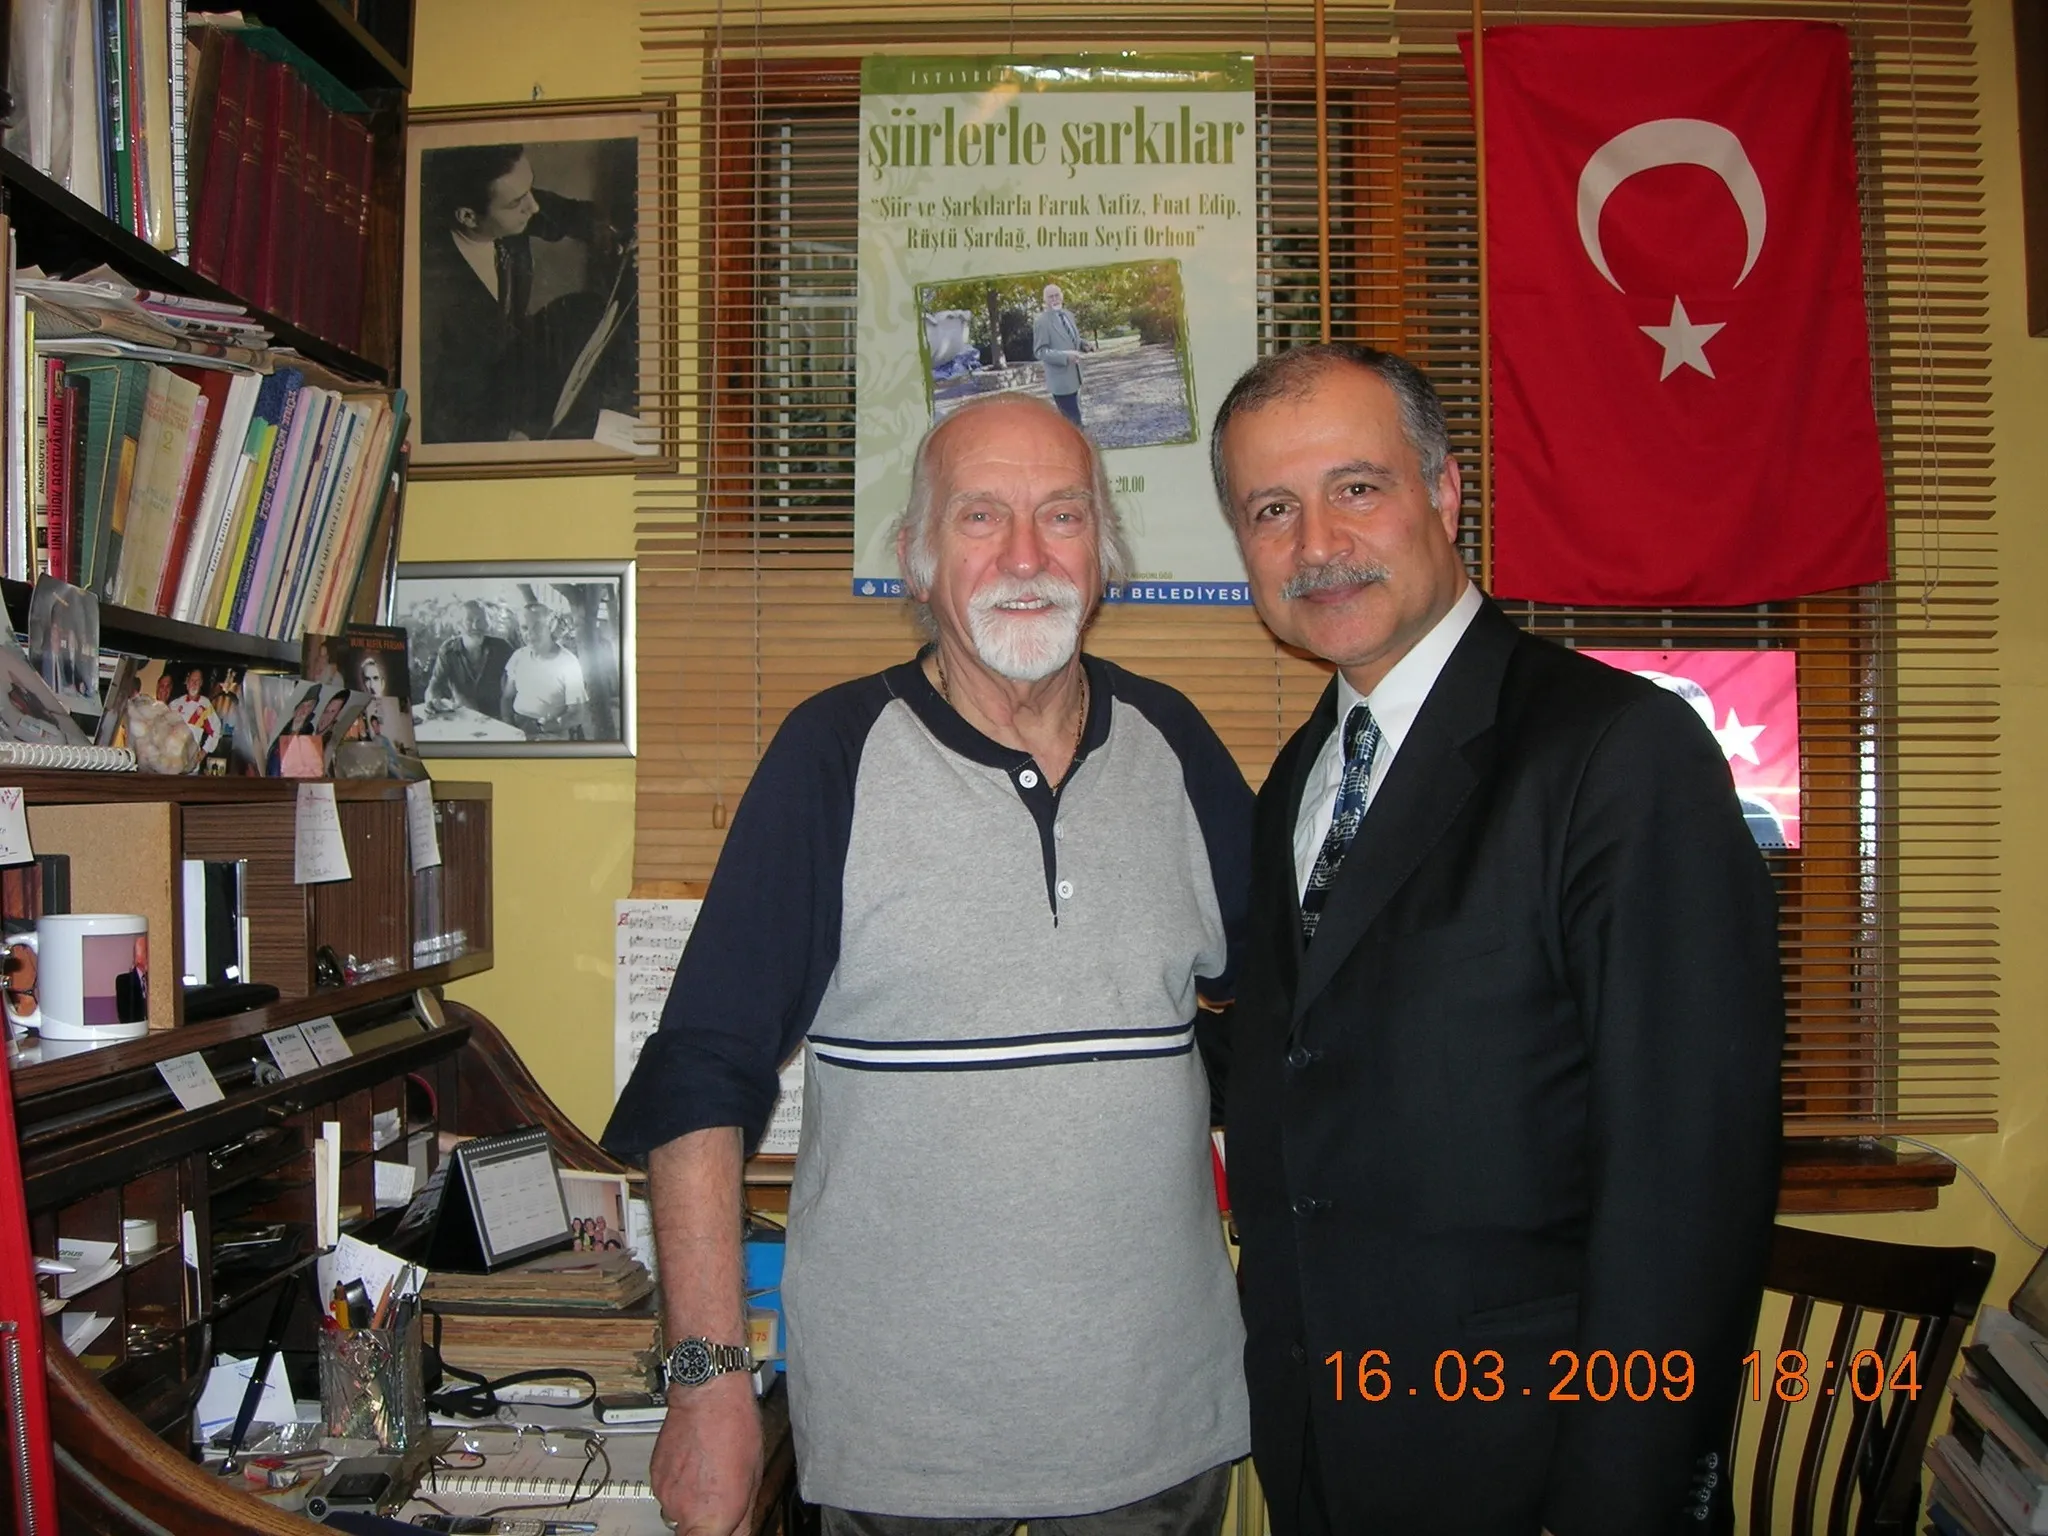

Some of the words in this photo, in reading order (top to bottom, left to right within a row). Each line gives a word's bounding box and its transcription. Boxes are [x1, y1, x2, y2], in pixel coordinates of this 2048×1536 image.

[868, 106, 1047, 181] şiirlerle
[1061, 105, 1245, 179] şarkılar
[917, 201, 936, 217] ve
[942, 194, 1032, 221] Şarkılarla
[1038, 193, 1090, 216] Faruk
[1199, 193, 1242, 220] Edip,
[1037, 225, 1089, 248] Orhan
[1115, 475, 1145, 493] 20.00
[1132, 585, 1249, 601] BELEDİYESİ
